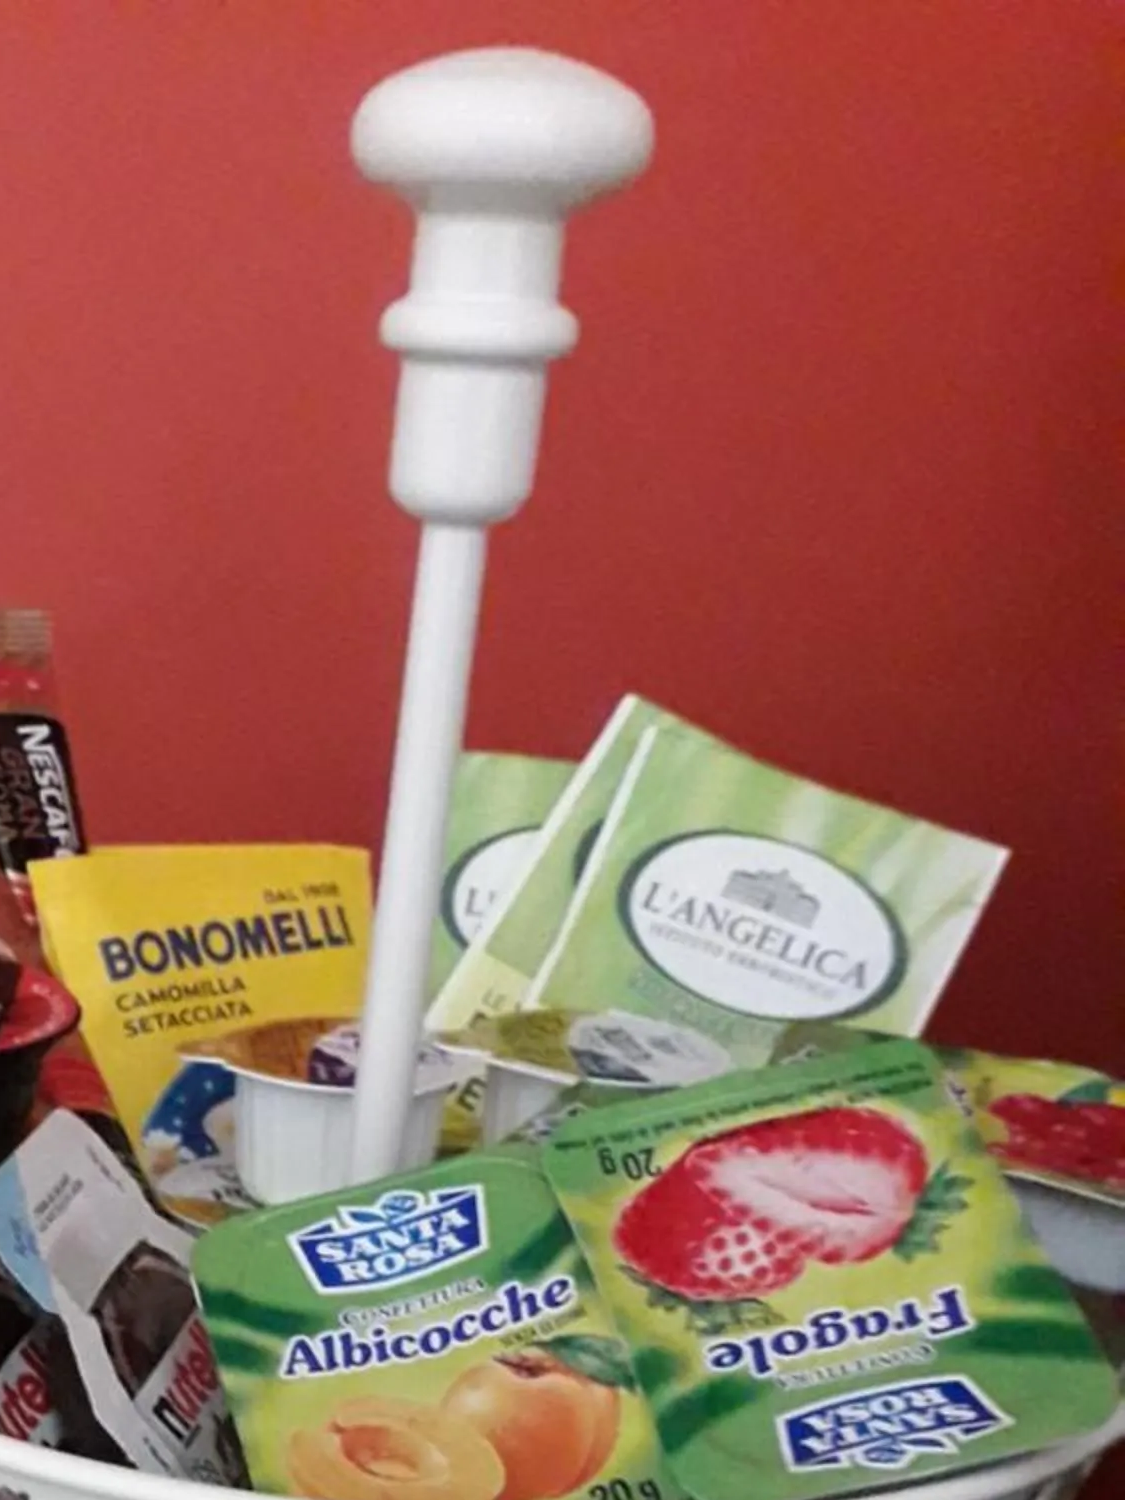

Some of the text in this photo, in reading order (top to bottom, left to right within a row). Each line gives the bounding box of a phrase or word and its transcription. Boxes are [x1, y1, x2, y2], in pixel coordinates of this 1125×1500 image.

[16, 724, 79, 857] NESCAF
[98, 905, 354, 982] BONOMELLI
[642, 881, 868, 990] L'ANGELICA
[114, 976, 247, 1013] CAMOMILLA
[122, 1000, 253, 1038] SETACCIATA
[621, 1149, 660, 1181] 20
[317, 1208, 471, 1265] SANTA
[336, 1233, 465, 1284] ROSA
[283, 1277, 572, 1378] Albicocche
[337, 1276, 487, 1330] CONFETTURA
[711, 1287, 968, 1374] Fragole
[148, 1319, 220, 1441] nutell
[802, 1383, 943, 1430] ROSA
[798, 1404, 979, 1455] SANTA
